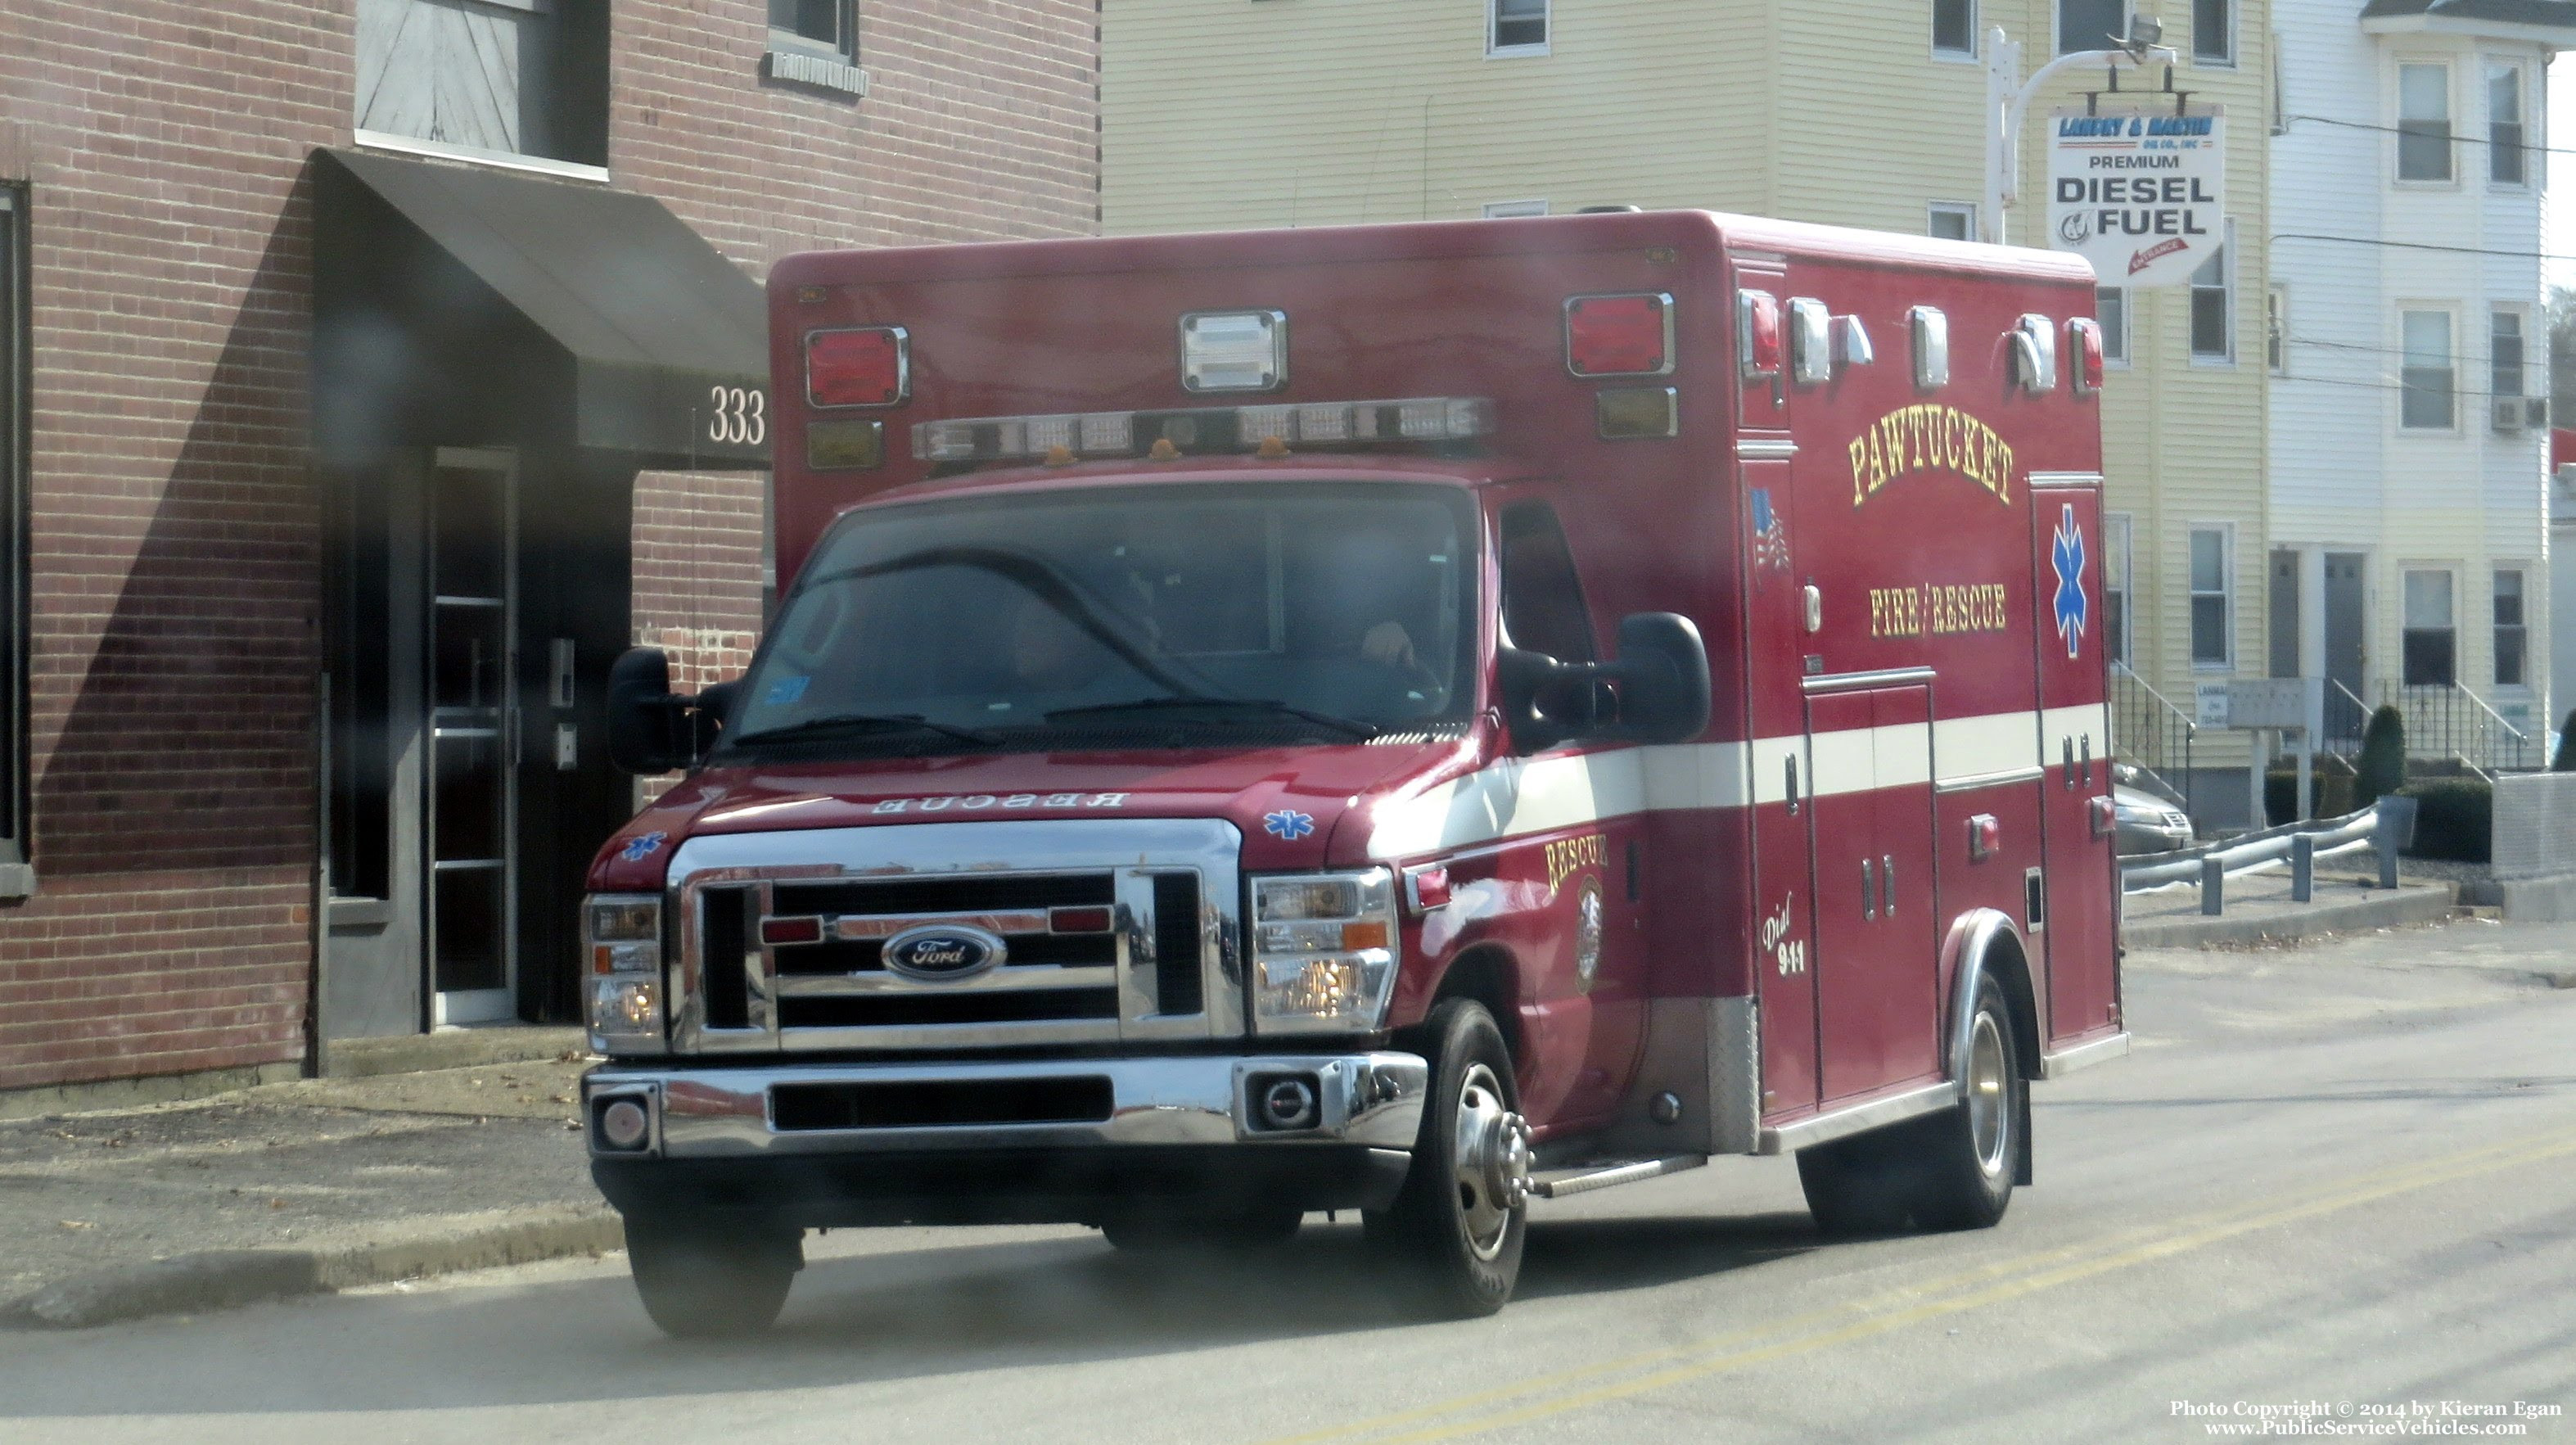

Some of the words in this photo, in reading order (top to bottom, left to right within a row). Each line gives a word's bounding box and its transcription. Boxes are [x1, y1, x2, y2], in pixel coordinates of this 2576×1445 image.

[2089, 156, 2180, 169] PREMIUM
[2056, 178, 2214, 203] DIESEL
[2097, 210, 2207, 235] FUEL
[710, 385, 765, 445] 333
[1848, 404, 2014, 508] PAWTUCKET
[1545, 834, 1608, 897] RESCUE
[1762, 891, 1792, 951] Dial
[912, 941, 966, 964] Ford
